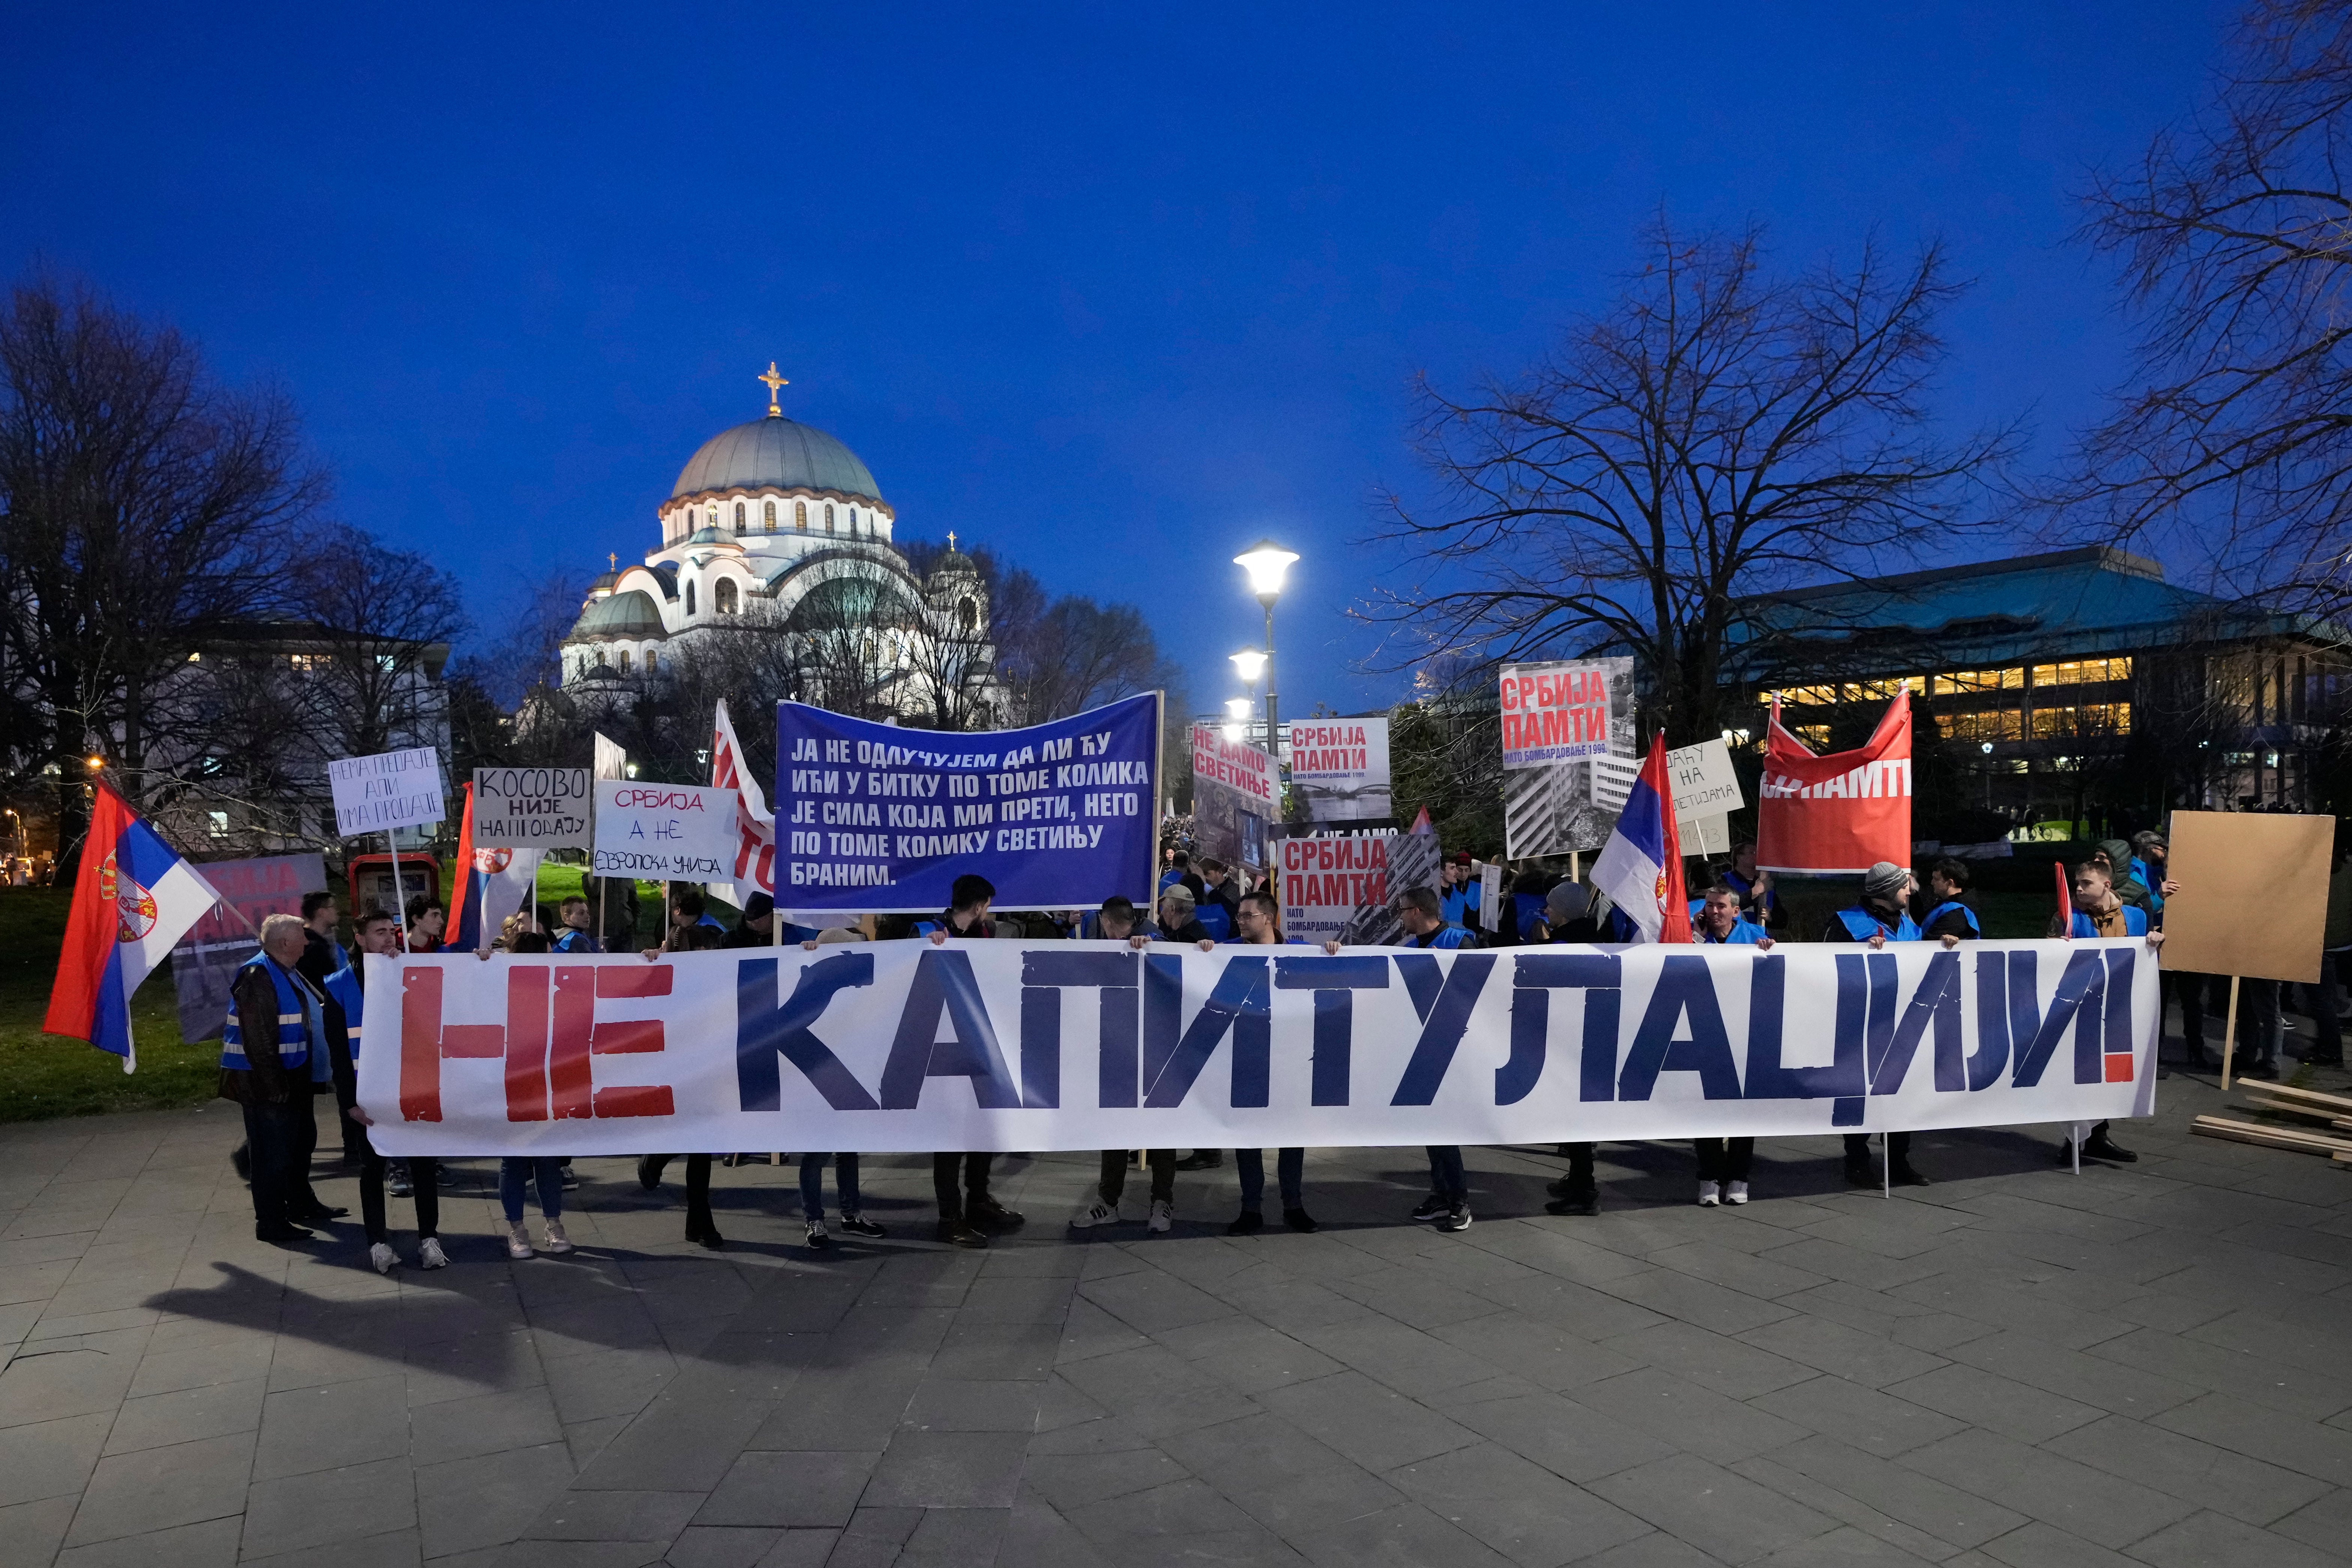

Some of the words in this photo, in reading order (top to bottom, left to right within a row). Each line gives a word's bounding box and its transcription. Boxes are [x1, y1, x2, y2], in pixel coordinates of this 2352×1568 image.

[1501, 671, 1606, 710] СРБИЈА
[1292, 727, 1366, 747] СРБИЈА
[1503, 706, 1606, 749] ПАМТИ
[331, 759, 370, 781] НЕМА
[374, 749, 435, 774] ПРЕДАЈЕ
[792, 738, 819, 761] ЈА
[826, 739, 850, 763] НЕ
[858, 740, 997, 769] ОДЛУЧУЈЕМ
[1003, 746, 1035, 770] ДА
[1042, 737, 1072, 762] ЛИ
[1080, 731, 1111, 756] ЋУ
[1194, 727, 1214, 752] НЕ
[1220, 738, 1265, 773] ДАМО
[1293, 748, 1366, 771] ПАМТИ
[1504, 751, 1522, 763] НАТО
[1524, 745, 1586, 762] БОМБАРДОВАЊЕ
[366, 777, 399, 799] АЛИ
[479, 769, 585, 798] КОСОВО
[792, 769, 839, 794] ИЋИ
[846, 772, 861, 795] У
[868, 772, 941, 797] БИТКУ
[948, 775, 979, 797] ПО
[986, 769, 1049, 796] ТОМЕ
[1057, 761, 1149, 788] КОЛИКА
[1194, 752, 1270, 799] СВЕТИЊЕ
[1679, 767, 1705, 786] НА
[338, 805, 371, 829] ИМА
[375, 791, 442, 823] ПРОДАЈЕ
[509, 799, 565, 816] НИЈЕ
[615, 790, 704, 812] СРБИЈА
[791, 801, 815, 824] ЈЕ
[823, 802, 881, 826] СИЛА
[888, 804, 946, 828] КОЈА
[954, 804, 993, 827] МИ
[1001, 795, 1076, 822] ПРЕТИ,
[1084, 793, 1138, 817] НЕГО
[629, 820, 644, 840] А
[653, 820, 683, 840] НЕ
[791, 831, 821, 855] ПО
[828, 832, 889, 857] ТОМЕ
[897, 830, 990, 858] КОЛИКУ
[996, 825, 1104, 852] СВЕТИЊУ
[595, 850, 668, 871] ЕВРОПСКА
[673, 855, 722, 875] УНИЈА
[1285, 839, 1387, 871] СРБИЈА
[791, 862, 896, 886] БРАНИМ.
[1287, 873, 1386, 906] ПАМТИ
[1287, 908, 1304, 918] НАТО
[1287, 921, 1345, 932] БОМБАРДОВАЊЕ
[399, 964, 675, 1122] НЕ
[737, 948, 2135, 1126] КАПИТУЛАЦИЈИ!
